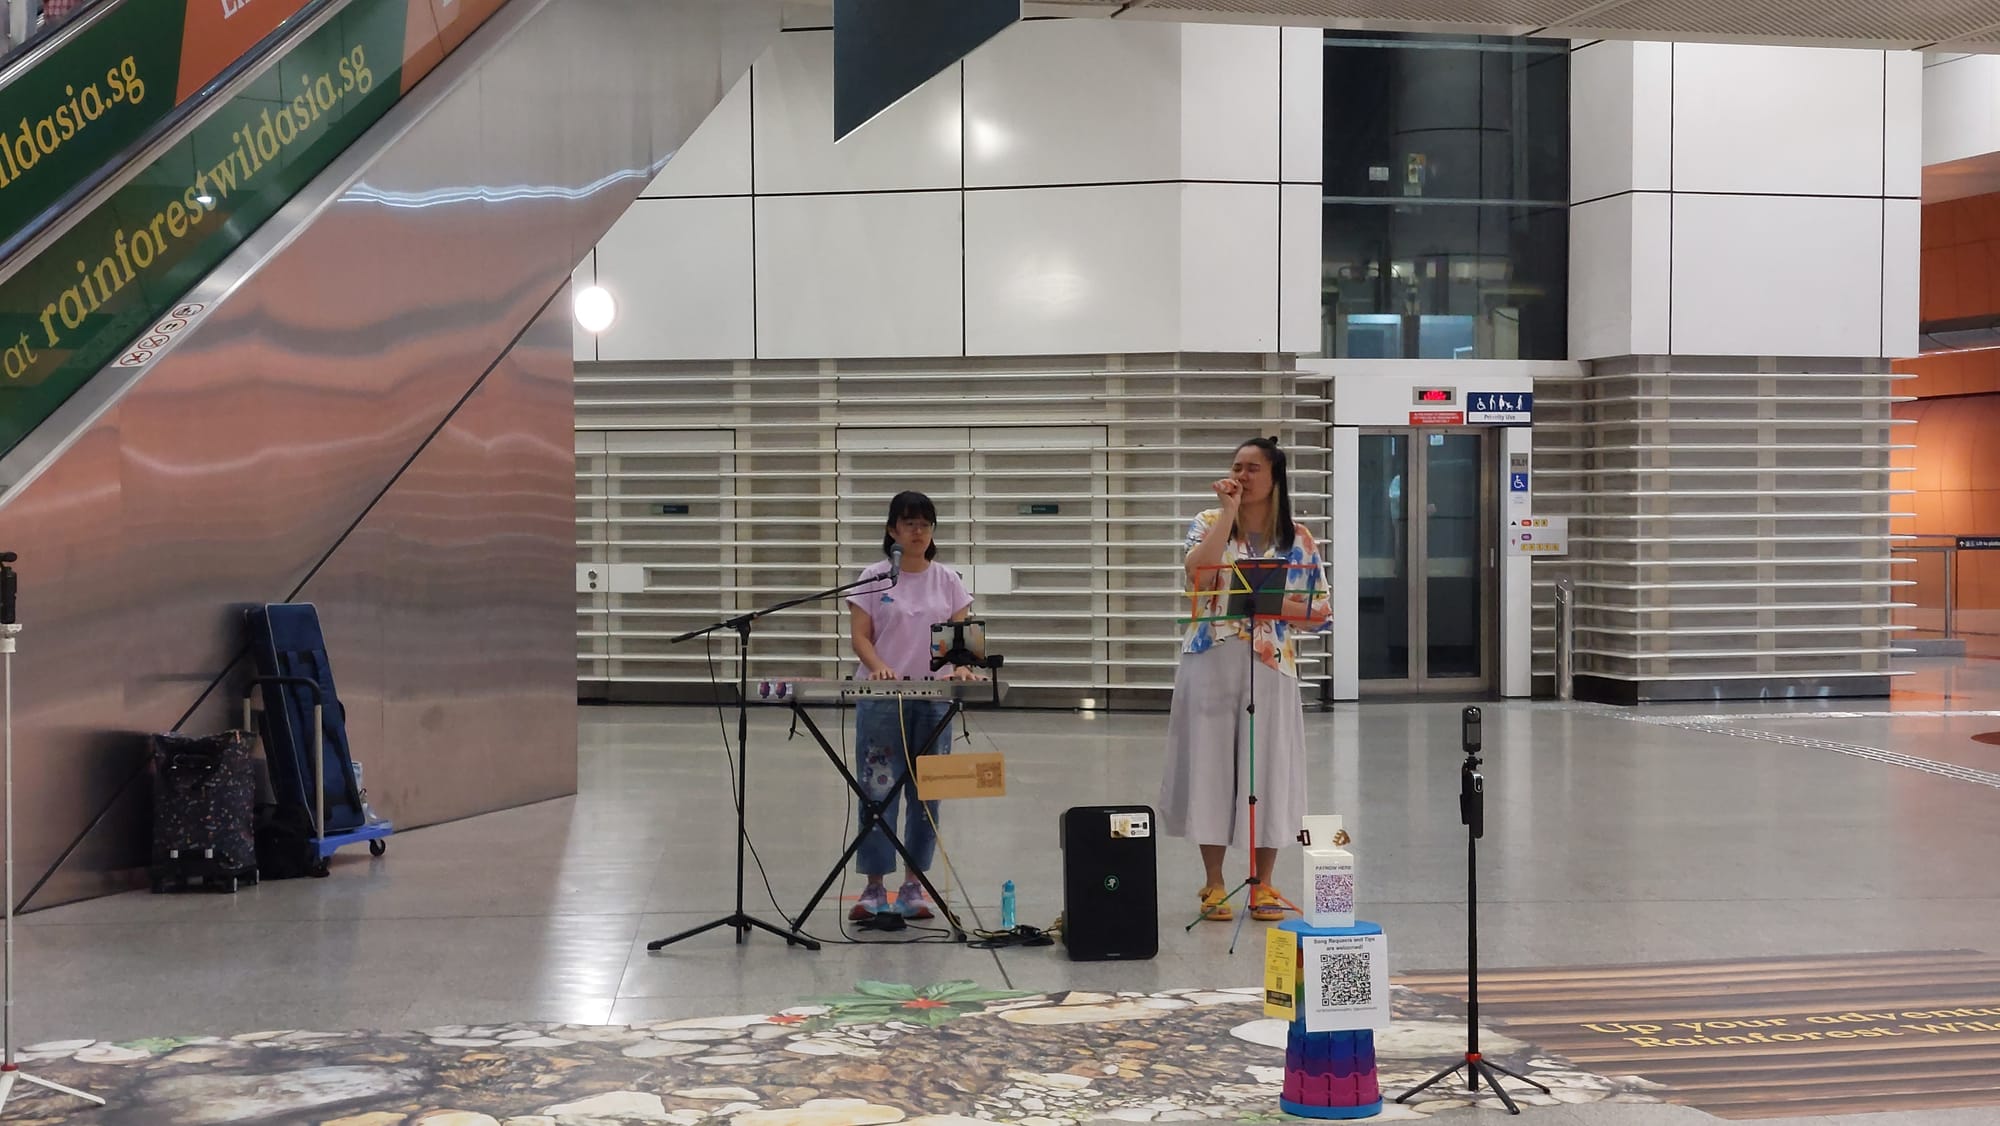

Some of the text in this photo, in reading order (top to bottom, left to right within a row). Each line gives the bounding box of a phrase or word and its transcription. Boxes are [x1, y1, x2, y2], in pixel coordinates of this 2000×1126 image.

[3, 44, 373, 379] at rainforestwildasia.sg
[1580, 1022, 1663, 1035] Up
[1672, 1017, 1789, 1033] your
[1623, 1020, 2000, 1048] Rainforest Wil
